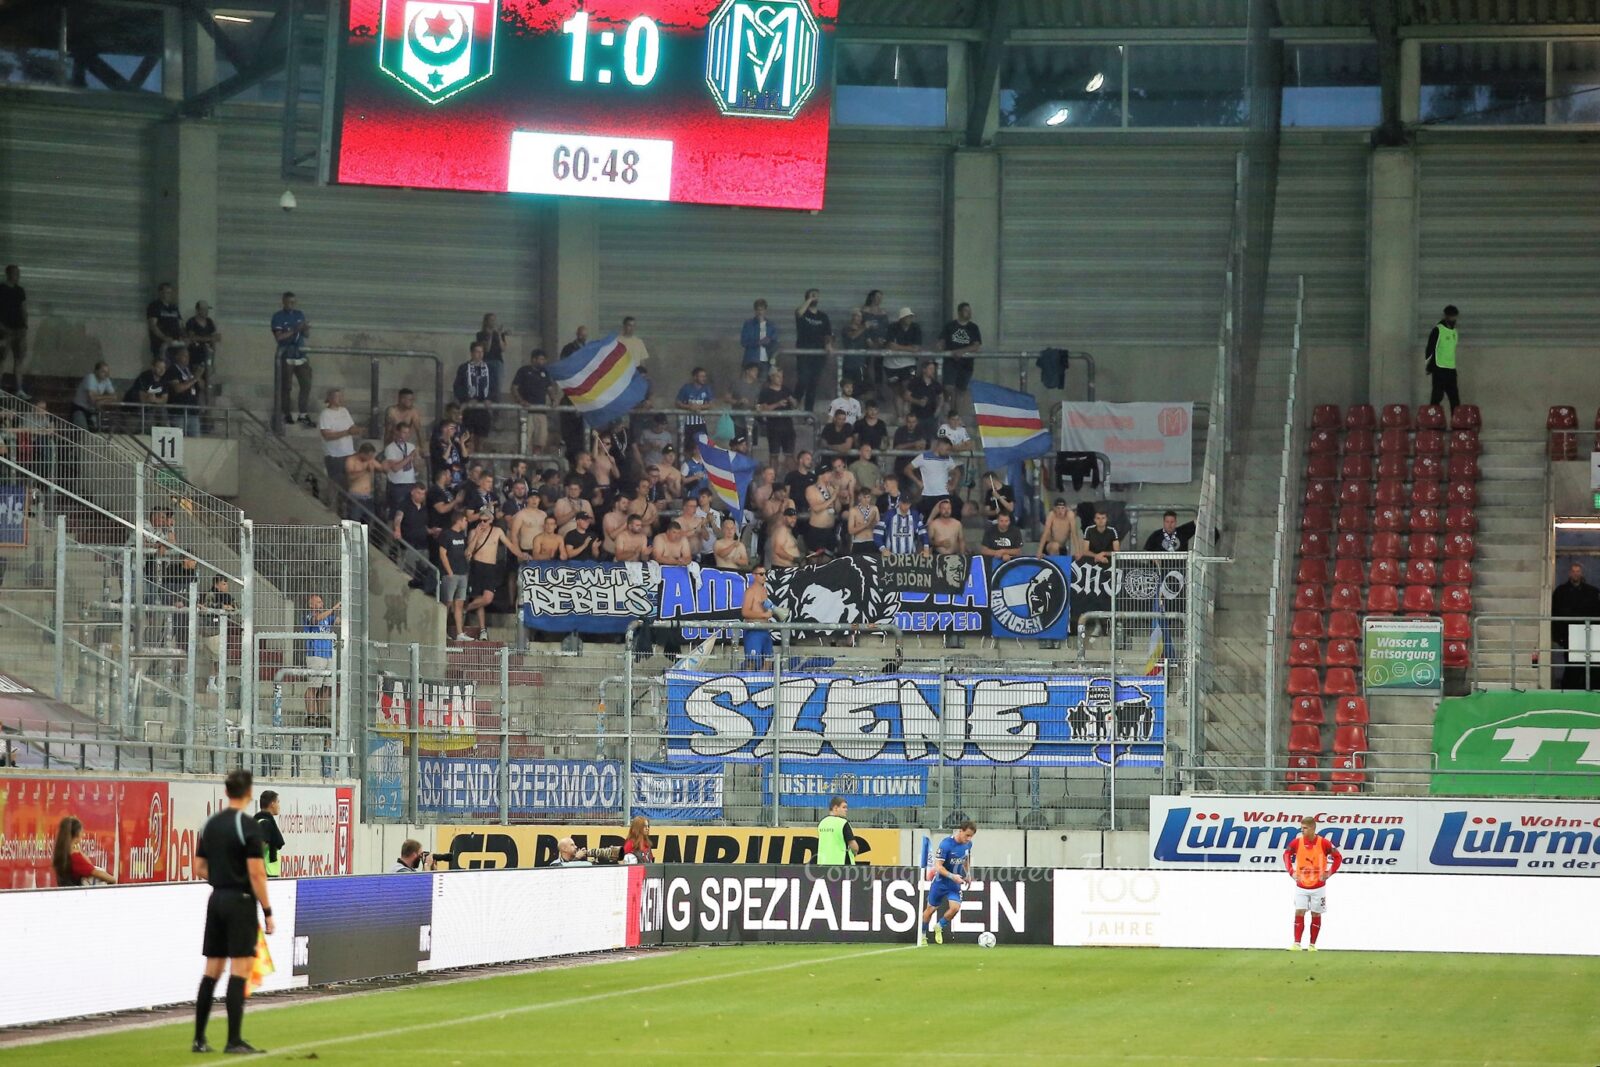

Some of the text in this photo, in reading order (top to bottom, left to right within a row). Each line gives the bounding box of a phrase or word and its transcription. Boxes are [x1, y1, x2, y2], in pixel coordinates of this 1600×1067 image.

[563, 11, 660, 87] 1:0
[552, 144, 642, 186] 60:48
[157, 435, 177, 459] 11
[896, 570, 932, 588] BJÖRN
[525, 585, 654, 617] REBELS
[893, 611, 982, 632] MEPPEN
[1376, 637, 1429, 648] Wasser &
[1369, 648, 1437, 662] Entsorgung
[416, 761, 625, 809] SCHENDRFERMOO
[859, 775, 921, 797] TOWN
[1243, 811, 1404, 825] WohnCentrum
[1153, 807, 1406, 863] Lührmann
[1429, 811, 1600, 868] Lührm
[130, 838, 154, 879] muth
[534, 834, 872, 866] PNBUR
[1249, 854, 1277, 864] an
[1328, 854, 1398, 866] aline
[1527, 860, 1555, 869] an
[1082, 873, 1161, 903] 100
[1088, 920, 1154, 937] JAHRE
